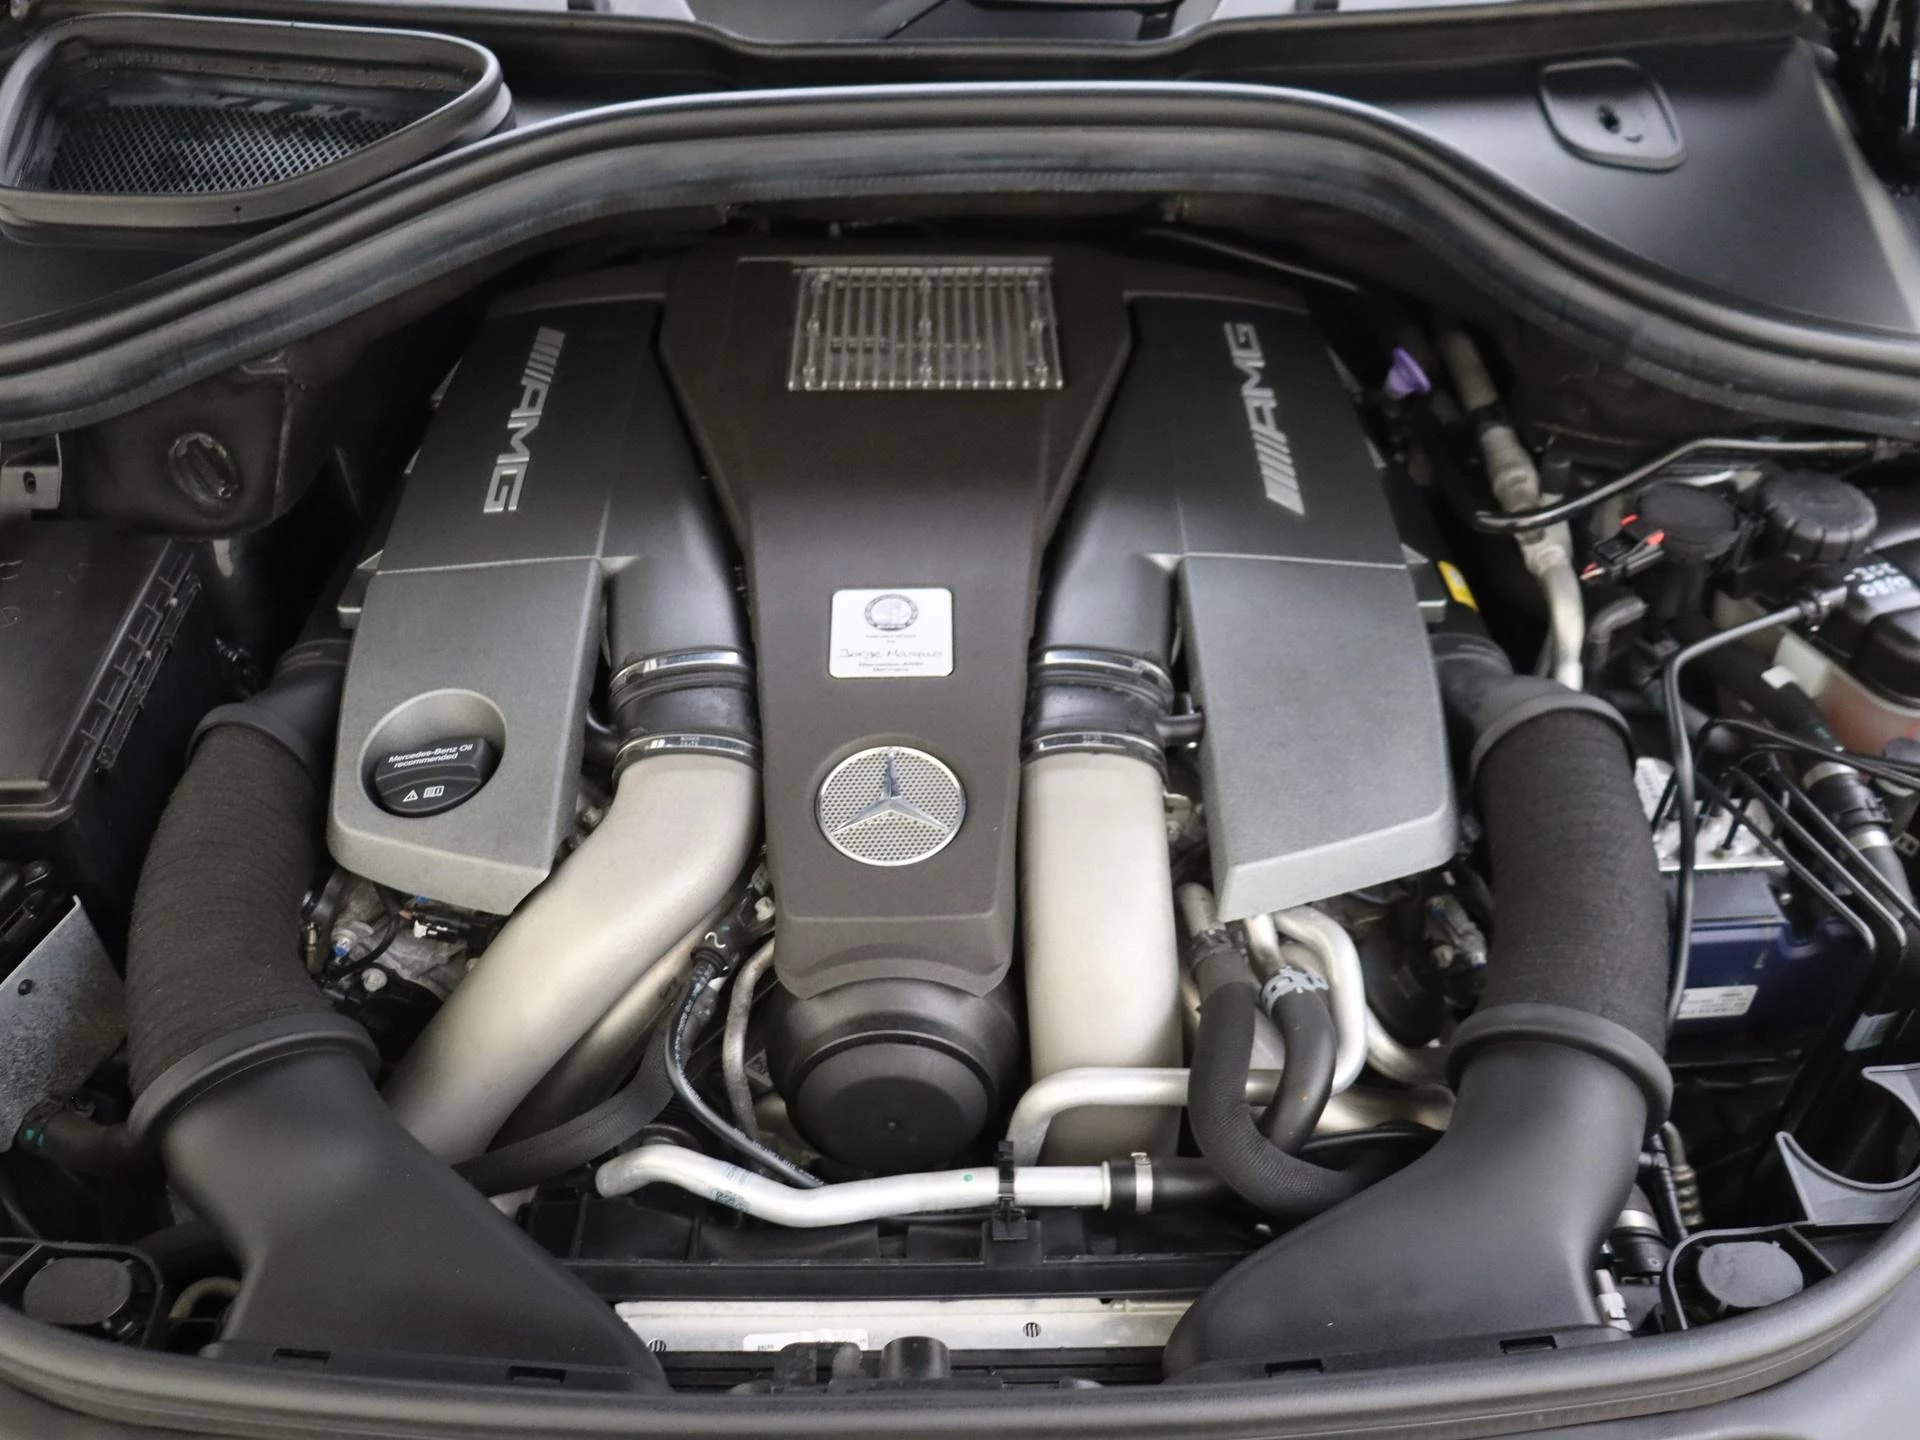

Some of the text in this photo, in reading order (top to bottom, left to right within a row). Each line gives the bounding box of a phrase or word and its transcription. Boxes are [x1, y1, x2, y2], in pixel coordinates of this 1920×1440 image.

[1224, 322, 1288, 448] AMG
[484, 370, 551, 512] AMG
[388, 743, 474, 763] Mercedes-Benz Oil
[393, 752, 459, 769] recommended
